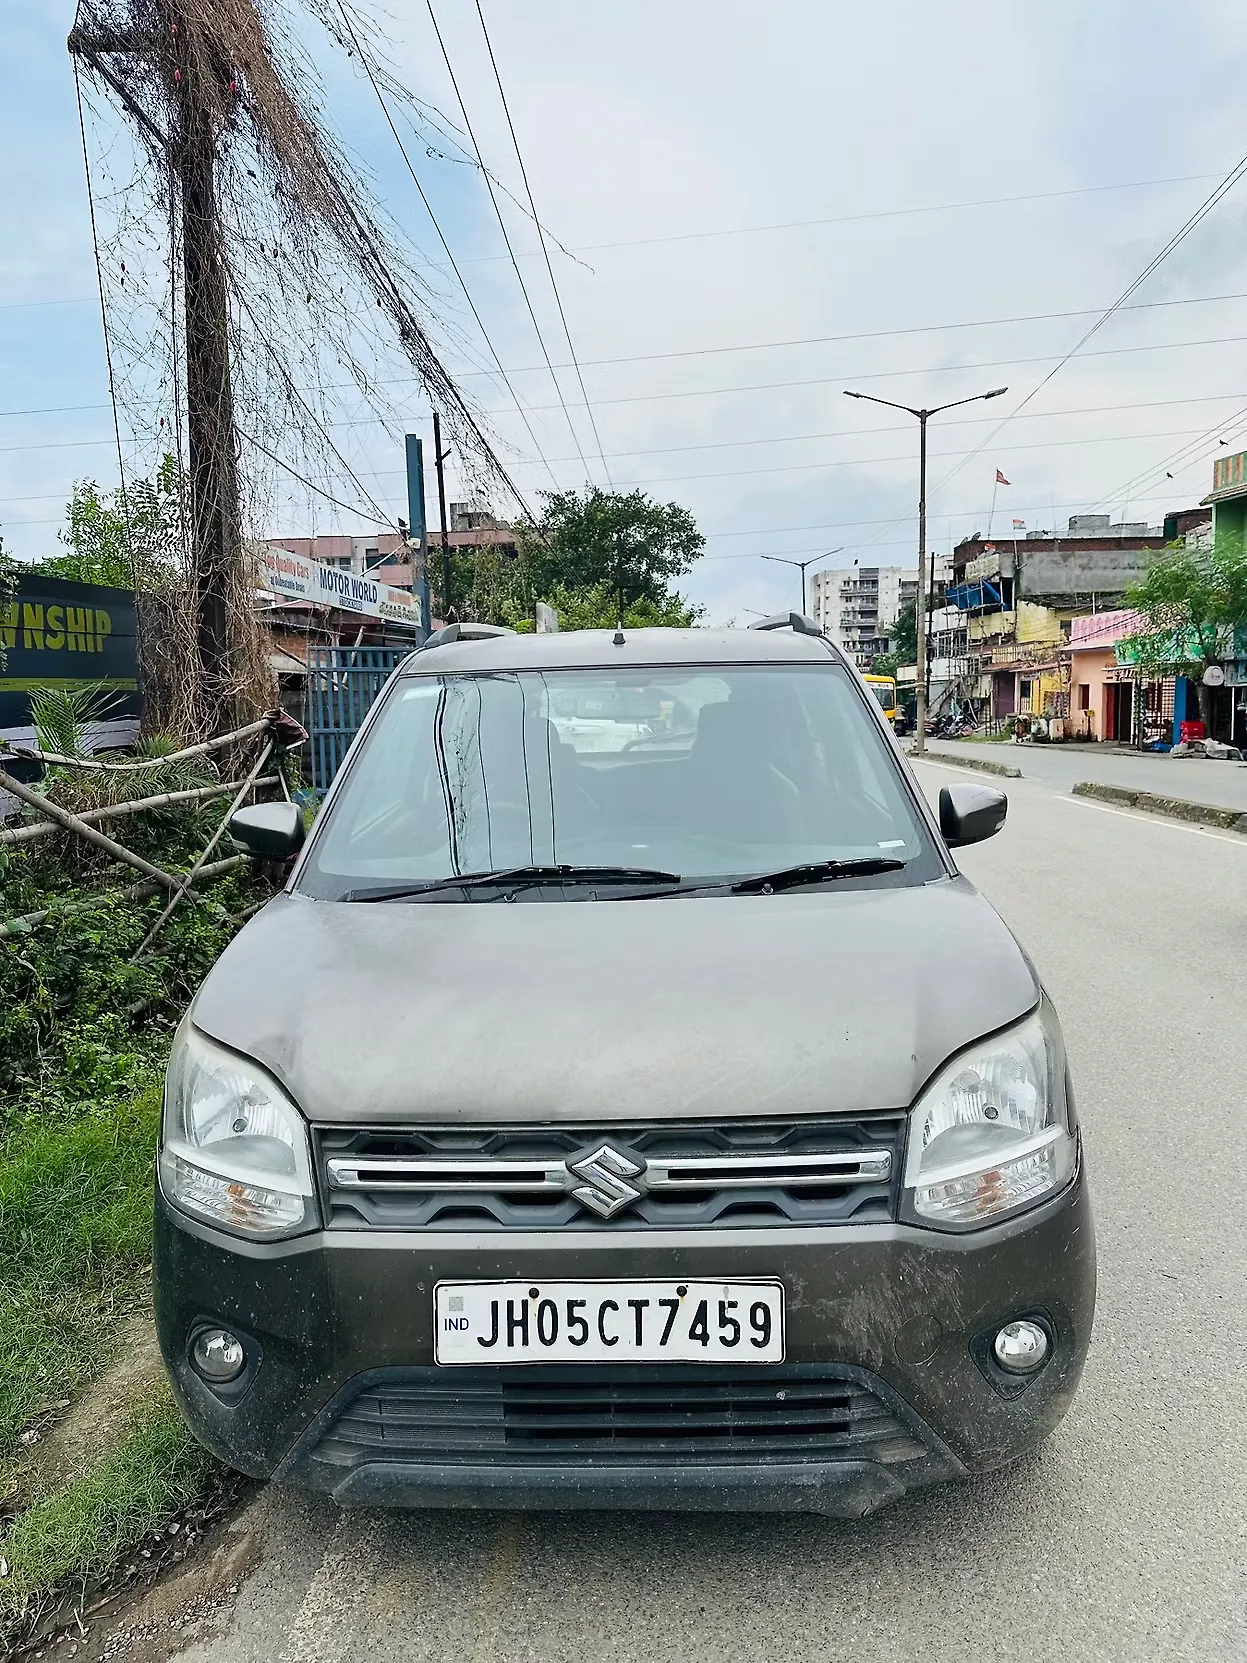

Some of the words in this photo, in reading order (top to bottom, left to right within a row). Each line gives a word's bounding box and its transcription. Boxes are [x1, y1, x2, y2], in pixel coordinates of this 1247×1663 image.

[319, 567, 350, 597] MOTOR
[351, 579, 378, 604] WORLD
[444, 1317, 470, 1331] IND
[477, 1299, 772, 1348] JH05CT7459
